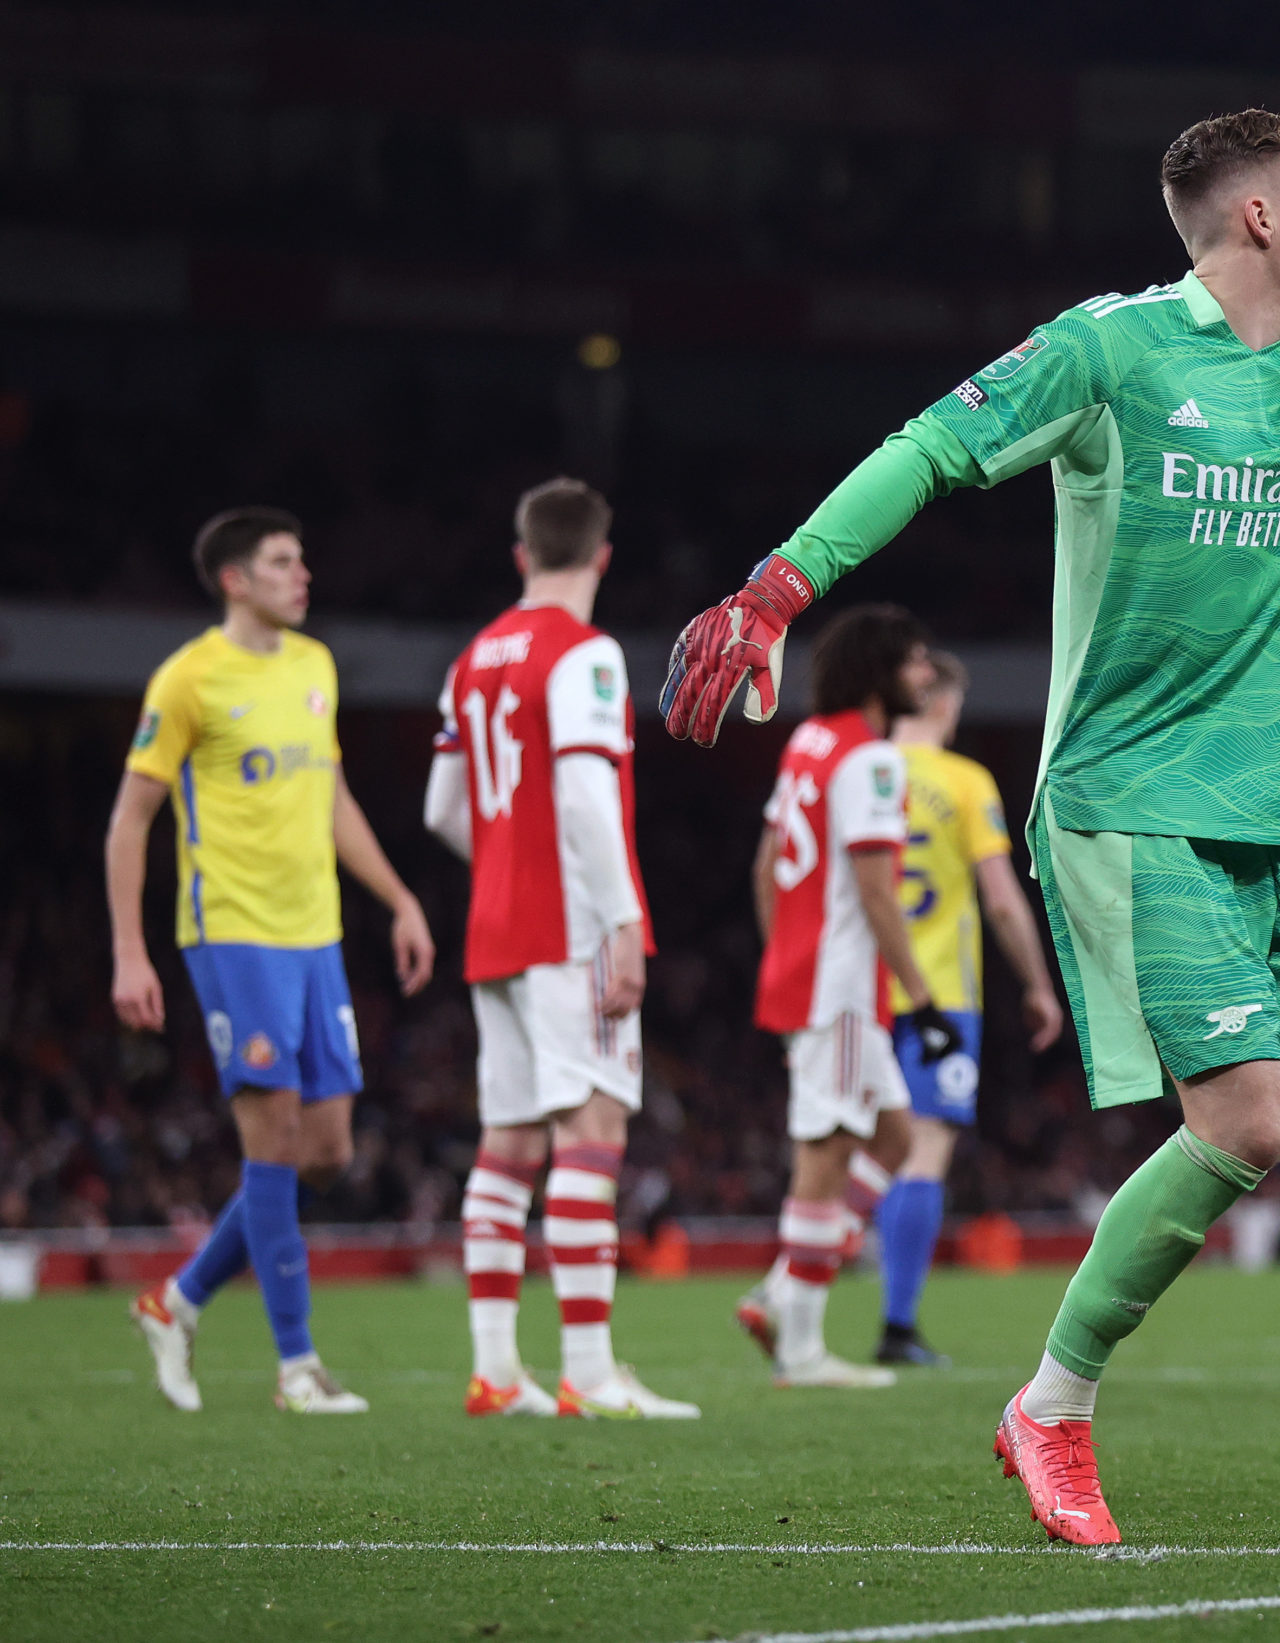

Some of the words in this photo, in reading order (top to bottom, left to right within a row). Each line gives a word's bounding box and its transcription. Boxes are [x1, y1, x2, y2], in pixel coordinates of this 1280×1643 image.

[1168, 417, 1209, 429] adidas
[1189, 508, 1233, 546] FLY
[778, 567, 787, 575] 1
[786, 574, 810, 603] LENO
